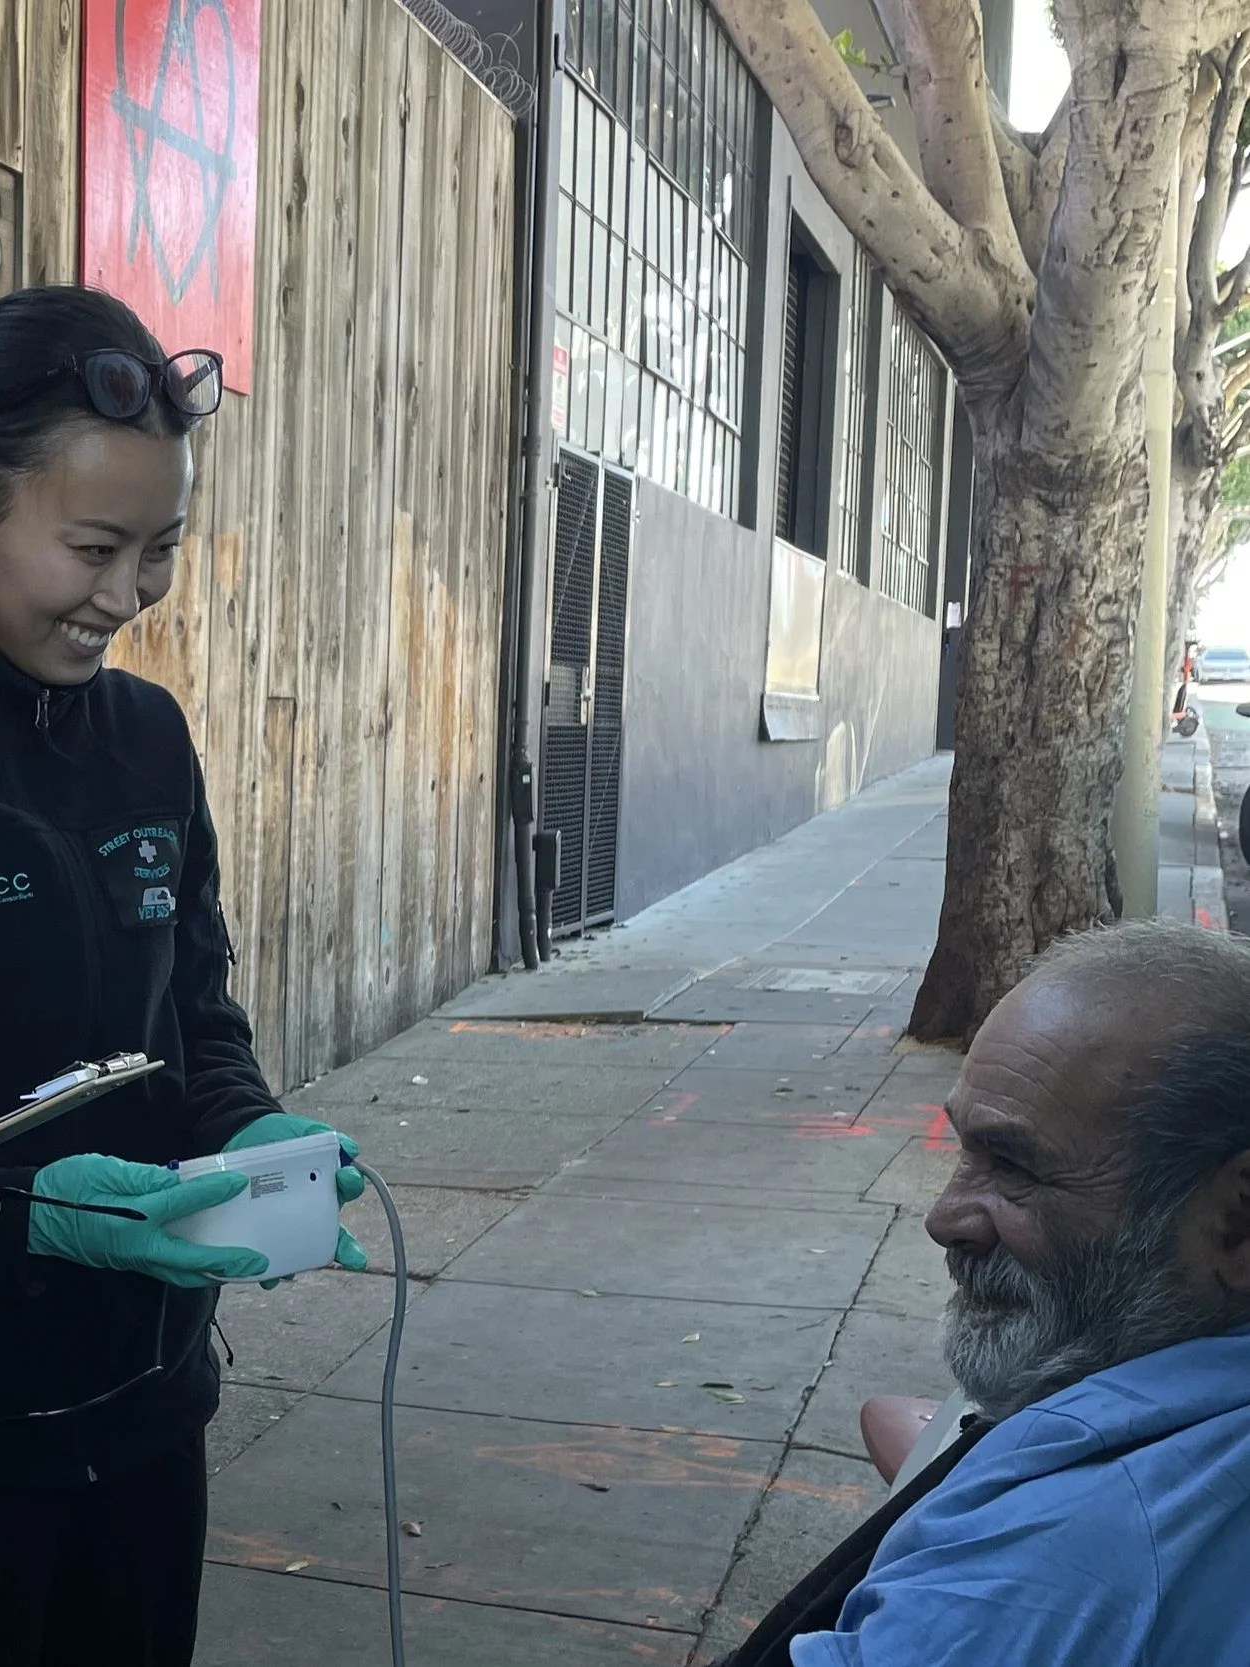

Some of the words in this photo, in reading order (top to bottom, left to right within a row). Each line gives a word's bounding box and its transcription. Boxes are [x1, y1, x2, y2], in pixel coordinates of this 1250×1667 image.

[98, 832, 130, 857] STREET
[133, 863, 171, 880] SERVICES
[138, 906, 156, 920] VET
